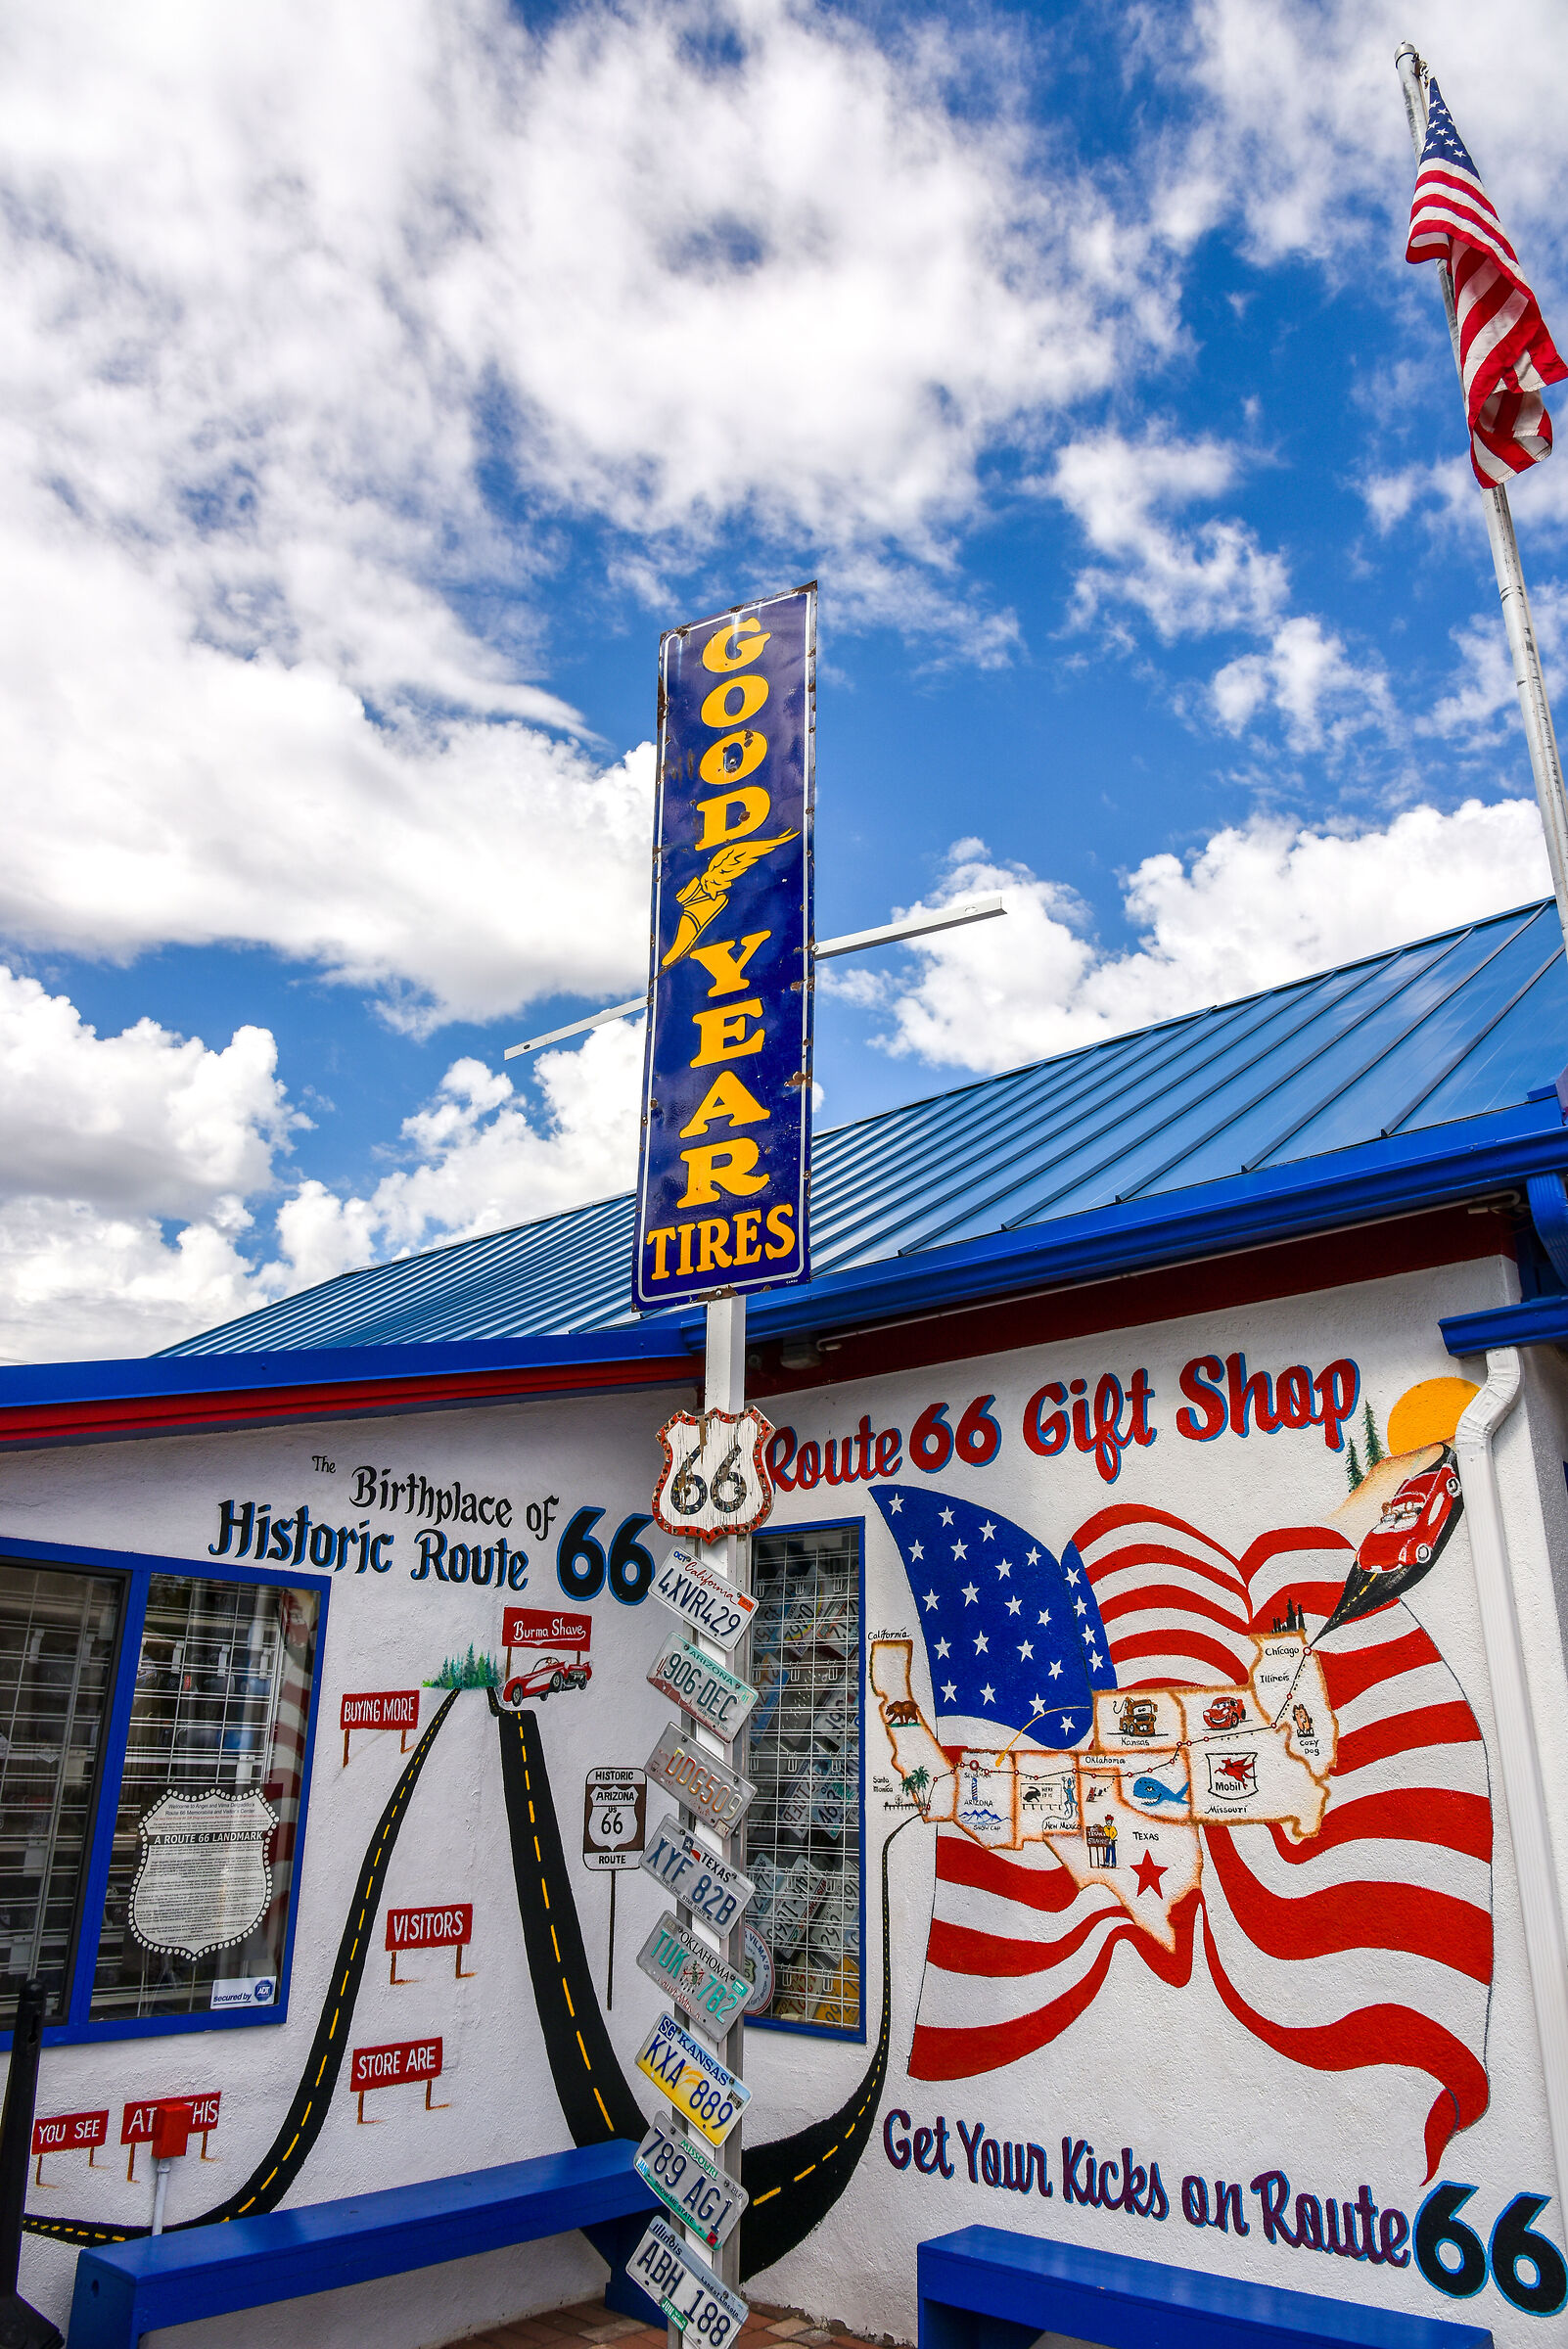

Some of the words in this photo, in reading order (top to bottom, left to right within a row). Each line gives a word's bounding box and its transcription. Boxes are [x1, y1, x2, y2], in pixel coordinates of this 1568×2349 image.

[647, 1203, 796, 1280] TIRES
[765, 1414, 903, 1493] Route
[908, 1394, 1003, 1474] 66
[1022, 1367, 1158, 1485] Gift
[1176, 1352, 1363, 1452] Shop
[669, 1443, 748, 1515] 66
[312, 1455, 337, 1474] The
[349, 1465, 513, 1528] Birthplace
[526, 1496, 560, 1542] of
[208, 1498, 394, 1575] Historic
[410, 1528, 530, 1591] Route
[556, 1504, 656, 1606] 66
[684, 1560, 739, 1606] California
[657, 1567, 741, 1638] 4XVR429
[513, 1620, 549, 1641] Burma
[551, 1617, 586, 1639] Shave
[867, 1626, 911, 1640] California
[1265, 1644, 1300, 1658] Chicago
[689, 1650, 734, 1686] ARIZONA
[1260, 1672, 1290, 1683] Illinois
[344, 1700, 381, 1723] BUYING
[383, 1696, 416, 1722] MORE
[1121, 1736, 1150, 1746] Kansas
[595, 1771, 634, 1781] HISTORIC
[1216, 1781, 1241, 1792] Mobil
[596, 1790, 635, 1802] ARIZONA
[964, 1799, 993, 1808] ARIZONA
[1204, 1805, 1248, 1816] Missouri
[154, 1835, 161, 1845] A
[164, 1834, 196, 1845] ROUTE
[198, 1833, 209, 1844] 66
[212, 1831, 263, 1843] LANDMARK
[600, 1813, 623, 1836] 66
[1132, 1831, 1160, 1841] TEXAS
[598, 1855, 626, 1865] ROUTE
[701, 1852, 732, 1883] TEXAS
[646, 1836, 695, 1883] XYF
[691, 1874, 737, 1926] 82B
[392, 1911, 465, 1943] VISITORS
[679, 1931, 731, 1983] OKLAHOMA
[650, 1928, 690, 1979] TUK
[696, 1973, 738, 2025] 782
[213, 1993, 244, 2003] secured
[244, 1992, 253, 2002] by
[256, 1986, 271, 1996] ADT
[659, 2018, 677, 2041] SG
[356, 2050, 401, 2080] STORE
[405, 2045, 437, 2074] ARE
[677, 2033, 730, 2087] KANSAS
[643, 2033, 687, 2090] KXA
[689, 2079, 734, 2130] 889
[38, 2123, 67, 2144] YOU
[74, 2119, 100, 2140] SEE
[127, 2106, 158, 2135] AT
[641, 2126, 688, 2188] 789
[680, 2139, 718, 2179] MISSOURI
[882, 2107, 955, 2180] Get
[955, 2119, 1054, 2199] Your
[1061, 2135, 1170, 2223] Kicks
[1180, 2172, 1250, 2238] on
[1249, 2168, 1411, 2271] Route
[1412, 2179, 1568, 2319] 66
[636, 2240, 687, 2299] ABH
[682, 2289, 731, 2347] 188
